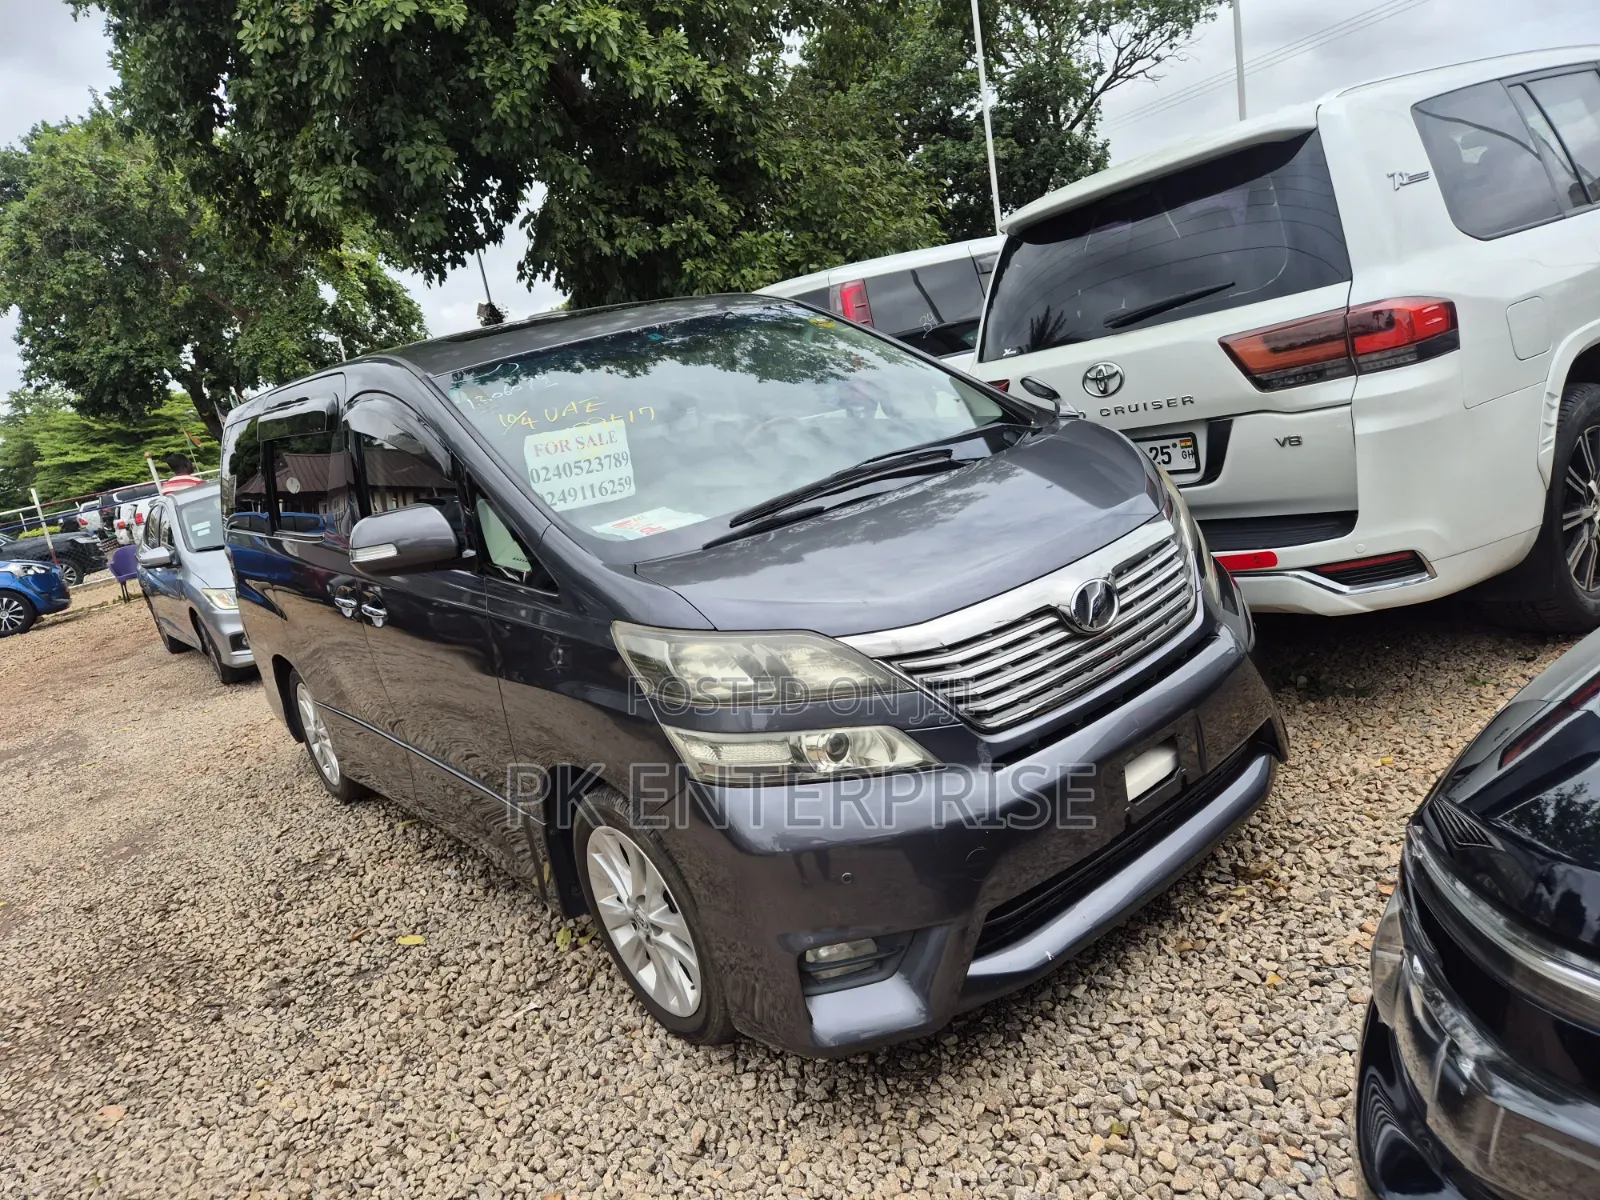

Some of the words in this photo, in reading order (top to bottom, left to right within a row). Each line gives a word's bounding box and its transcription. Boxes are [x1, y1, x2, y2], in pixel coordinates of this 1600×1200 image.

[544, 396, 608, 423] UAE
[1099, 394, 1196, 417] CRUISER
[533, 439, 573, 458] FOR
[574, 430, 618, 451] SALE
[1274, 434, 1303, 448] V8
[529, 450, 630, 484] 0240523789
